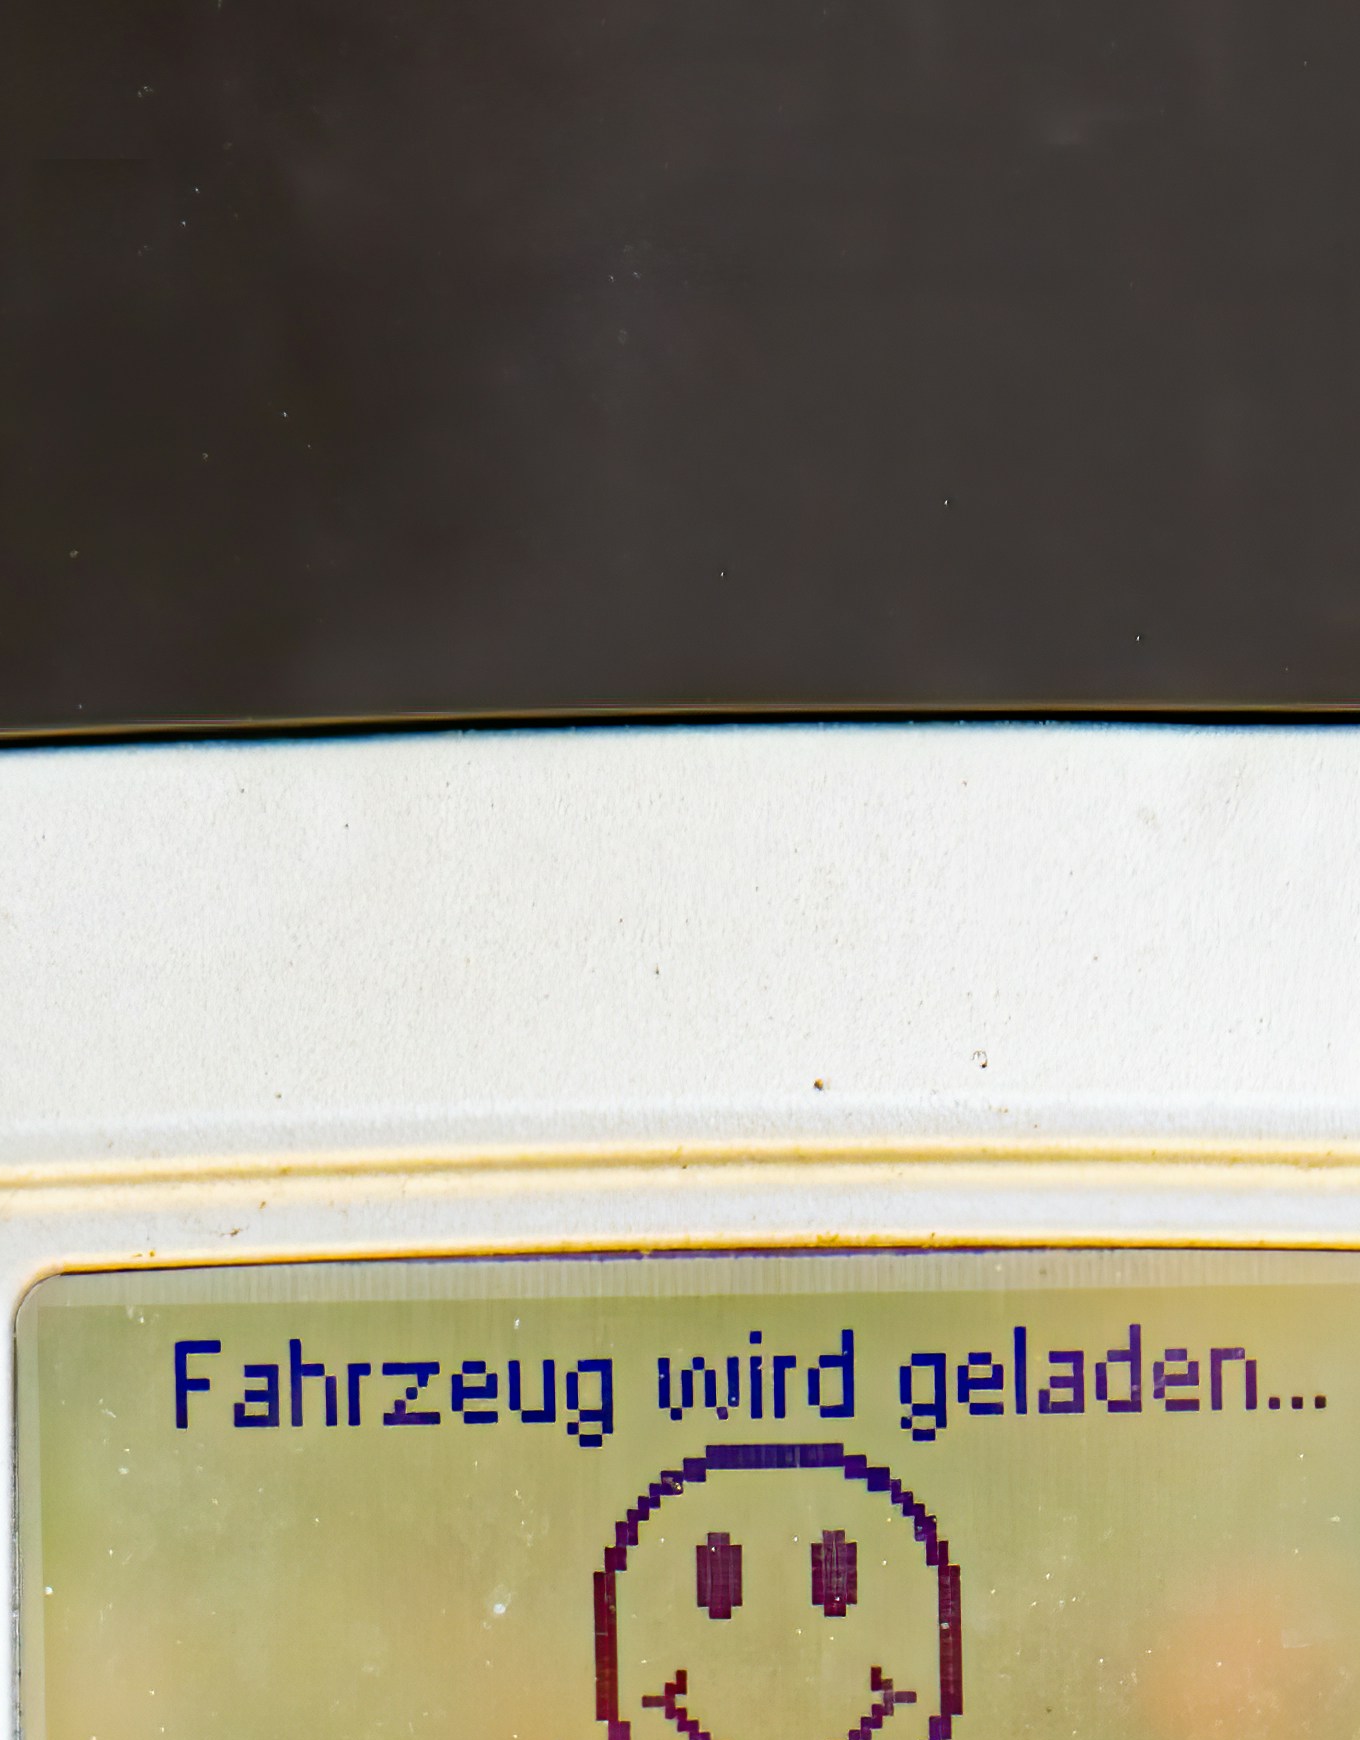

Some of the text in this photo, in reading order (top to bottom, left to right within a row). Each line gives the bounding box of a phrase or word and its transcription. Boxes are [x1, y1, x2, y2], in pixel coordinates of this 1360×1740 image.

[174, 1323, 1327, 1448] Fahrzeug wird geladen...
